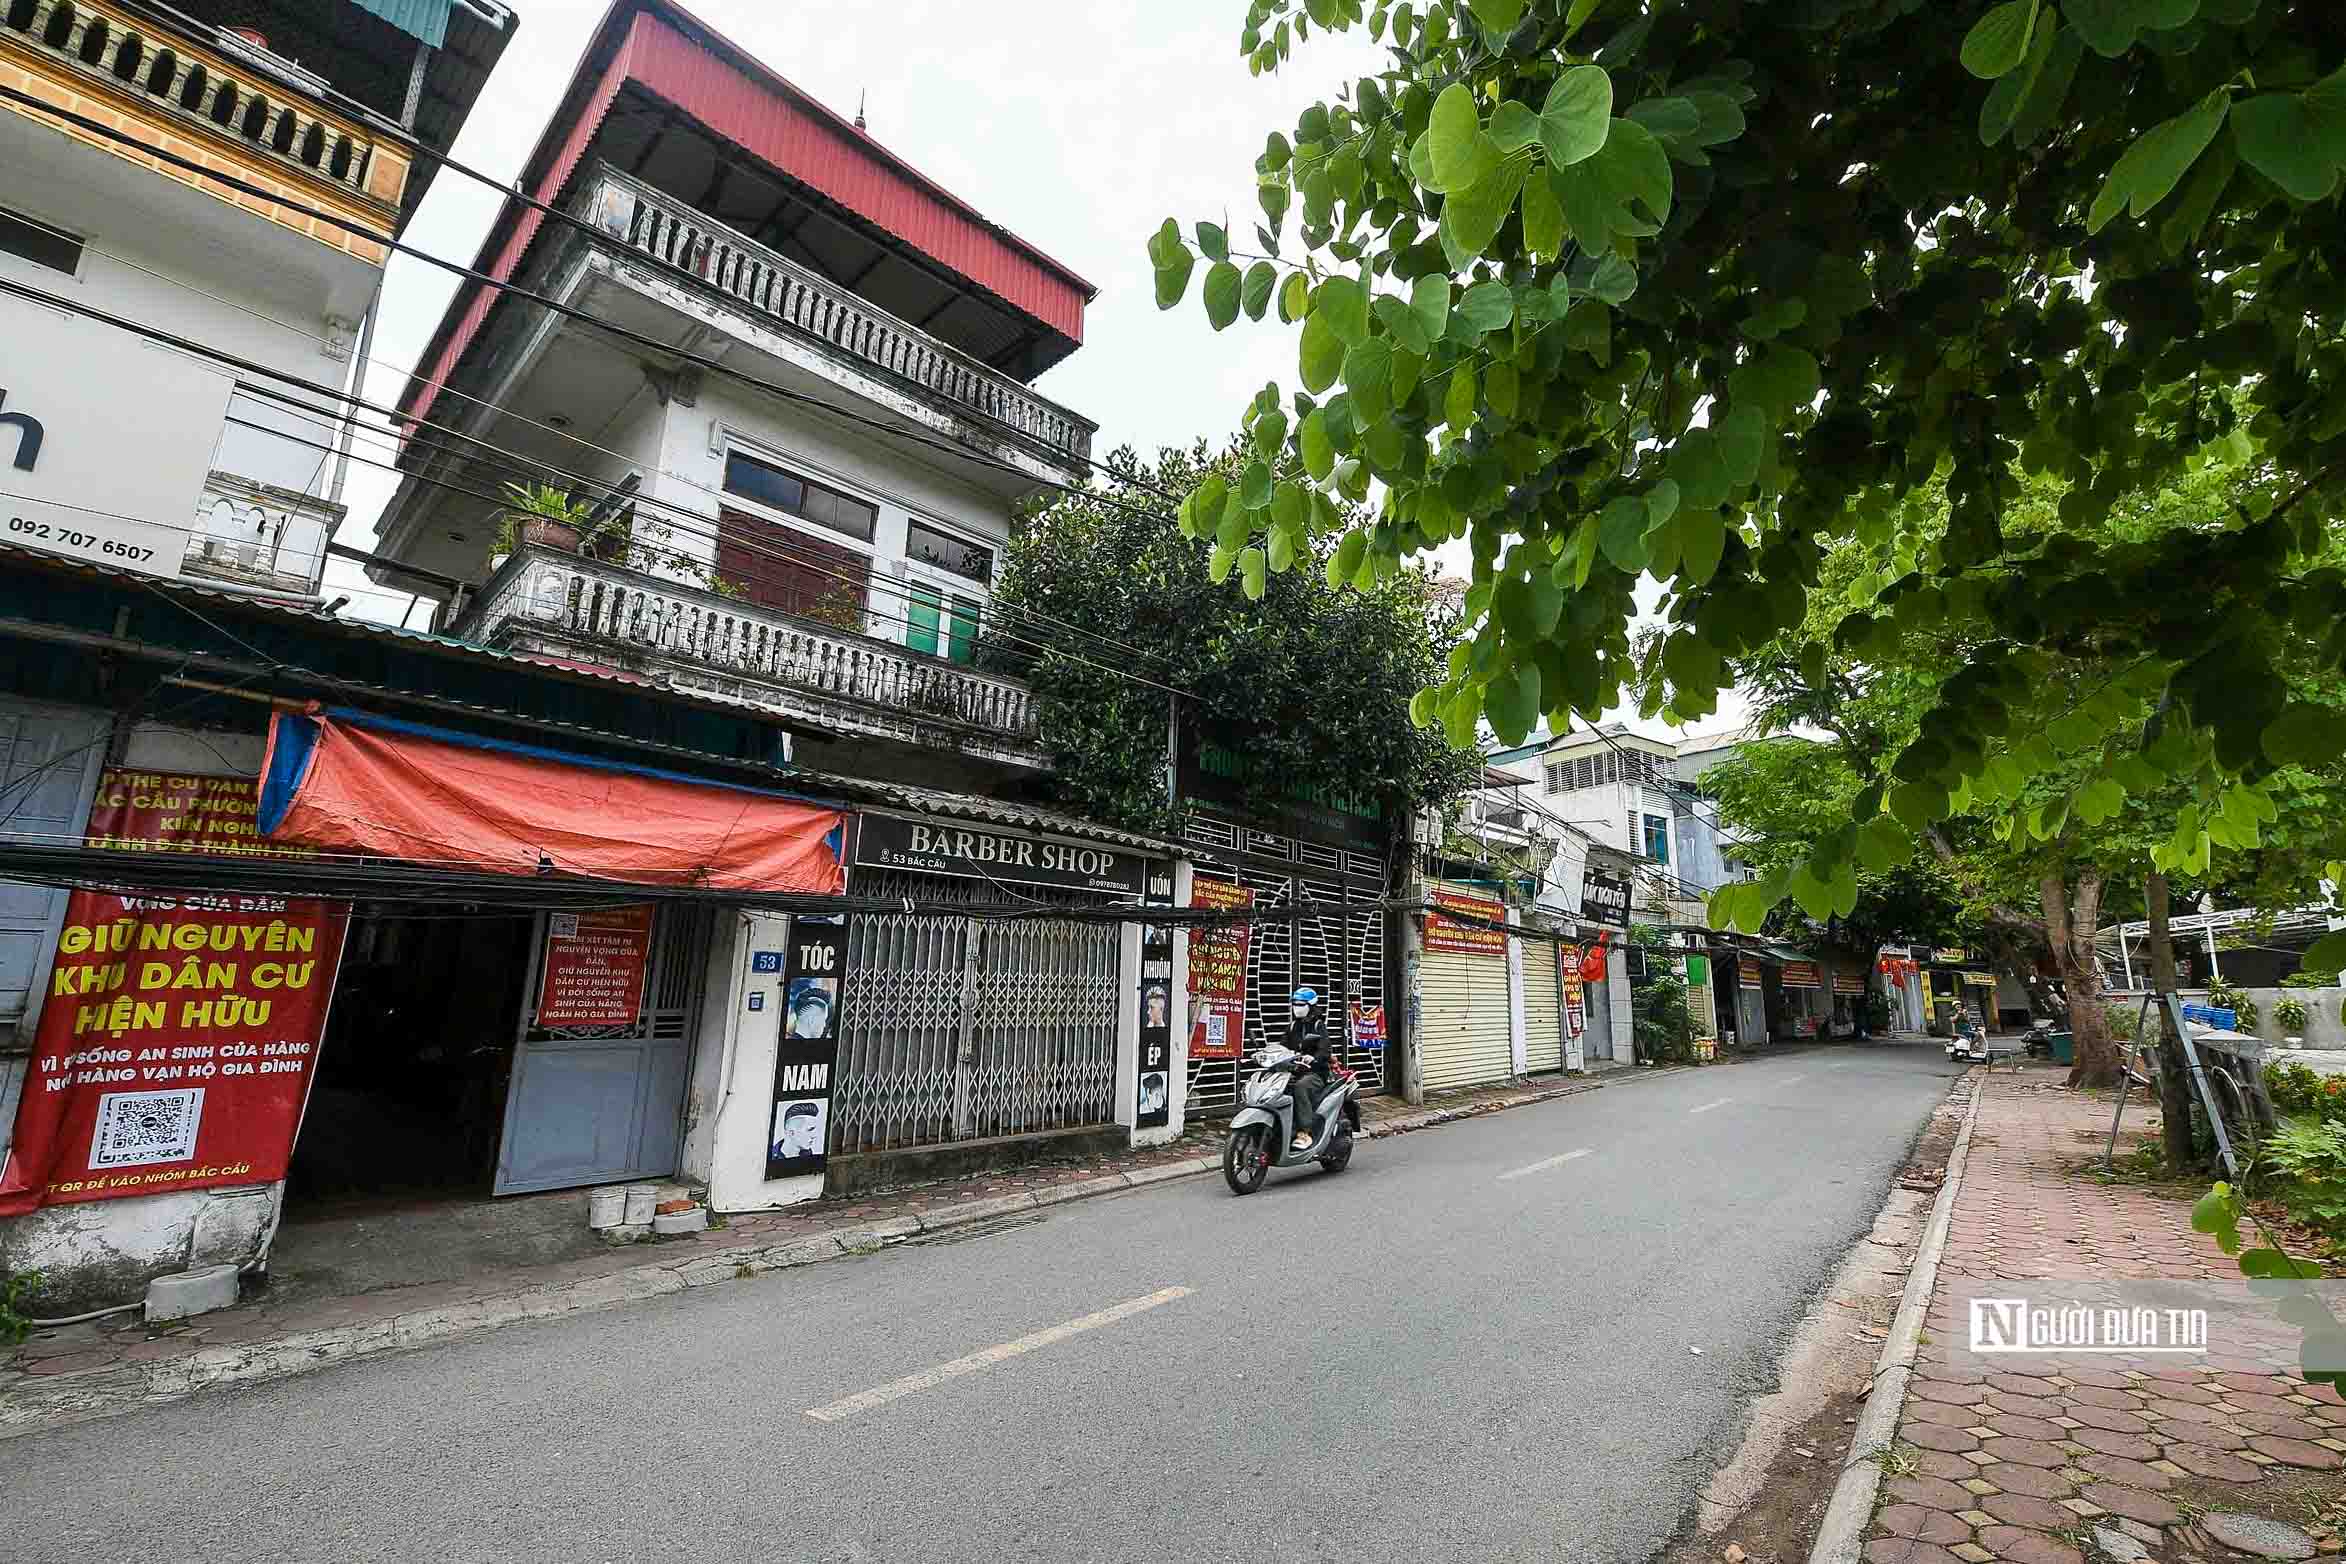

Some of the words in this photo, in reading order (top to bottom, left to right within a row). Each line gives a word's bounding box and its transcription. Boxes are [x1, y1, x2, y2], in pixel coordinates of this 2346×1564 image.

[9, 517, 50, 539] 092
[57, 528, 97, 548] 707
[102, 540, 154, 562] 6507
[892, 853, 906, 864] 53
[908, 824, 1034, 867] BARBER
[1041, 843, 1115, 876] SHOP
[1151, 871, 1171, 897] UỐN
[59, 918, 138, 954] GIỮ
[139, 919, 316, 953] NGUYÊN
[759, 954, 776, 970] 53
[800, 940, 835, 971] TÓC
[54, 961, 127, 997] KHU
[139, 955, 238, 990] DÂN
[251, 959, 316, 989] CƯ
[612, 968, 630, 976] KHU
[1143, 958, 1171, 983] NHUỘM
[554, 999, 576, 1007] SINH
[577, 998, 596, 1008] CỦA
[598, 998, 624, 1008] HÀNG
[612, 989, 625, 997] AN
[181, 994, 272, 1027] HỮU
[574, 1010, 588, 1019] HỘ
[589, 1010, 606, 1019] GIA
[607, 1009, 629, 1019] ĐÌNH
[41, 1055, 57, 1072] VÌ
[75, 1045, 132, 1065] SỐNG
[137, 1049, 165, 1062] AN
[171, 1046, 215, 1060] SINH
[219, 1041, 258, 1057] CỦA
[262, 1042, 311, 1056] HÀNG
[1147, 1044, 1161, 1066] ÉP
[77, 1067, 137, 1084] HÀNG
[143, 1064, 182, 1082] VẠN
[187, 1062, 216, 1080] HỘ
[222, 1063, 255, 1075] GIA
[260, 1059, 303, 1073] ĐÌNH
[782, 1063, 829, 1092] NAM
[60, 1182, 82, 1193] QR
[110, 1176, 141, 1187] VÀO
[144, 1169, 185, 1184] NHÓM
